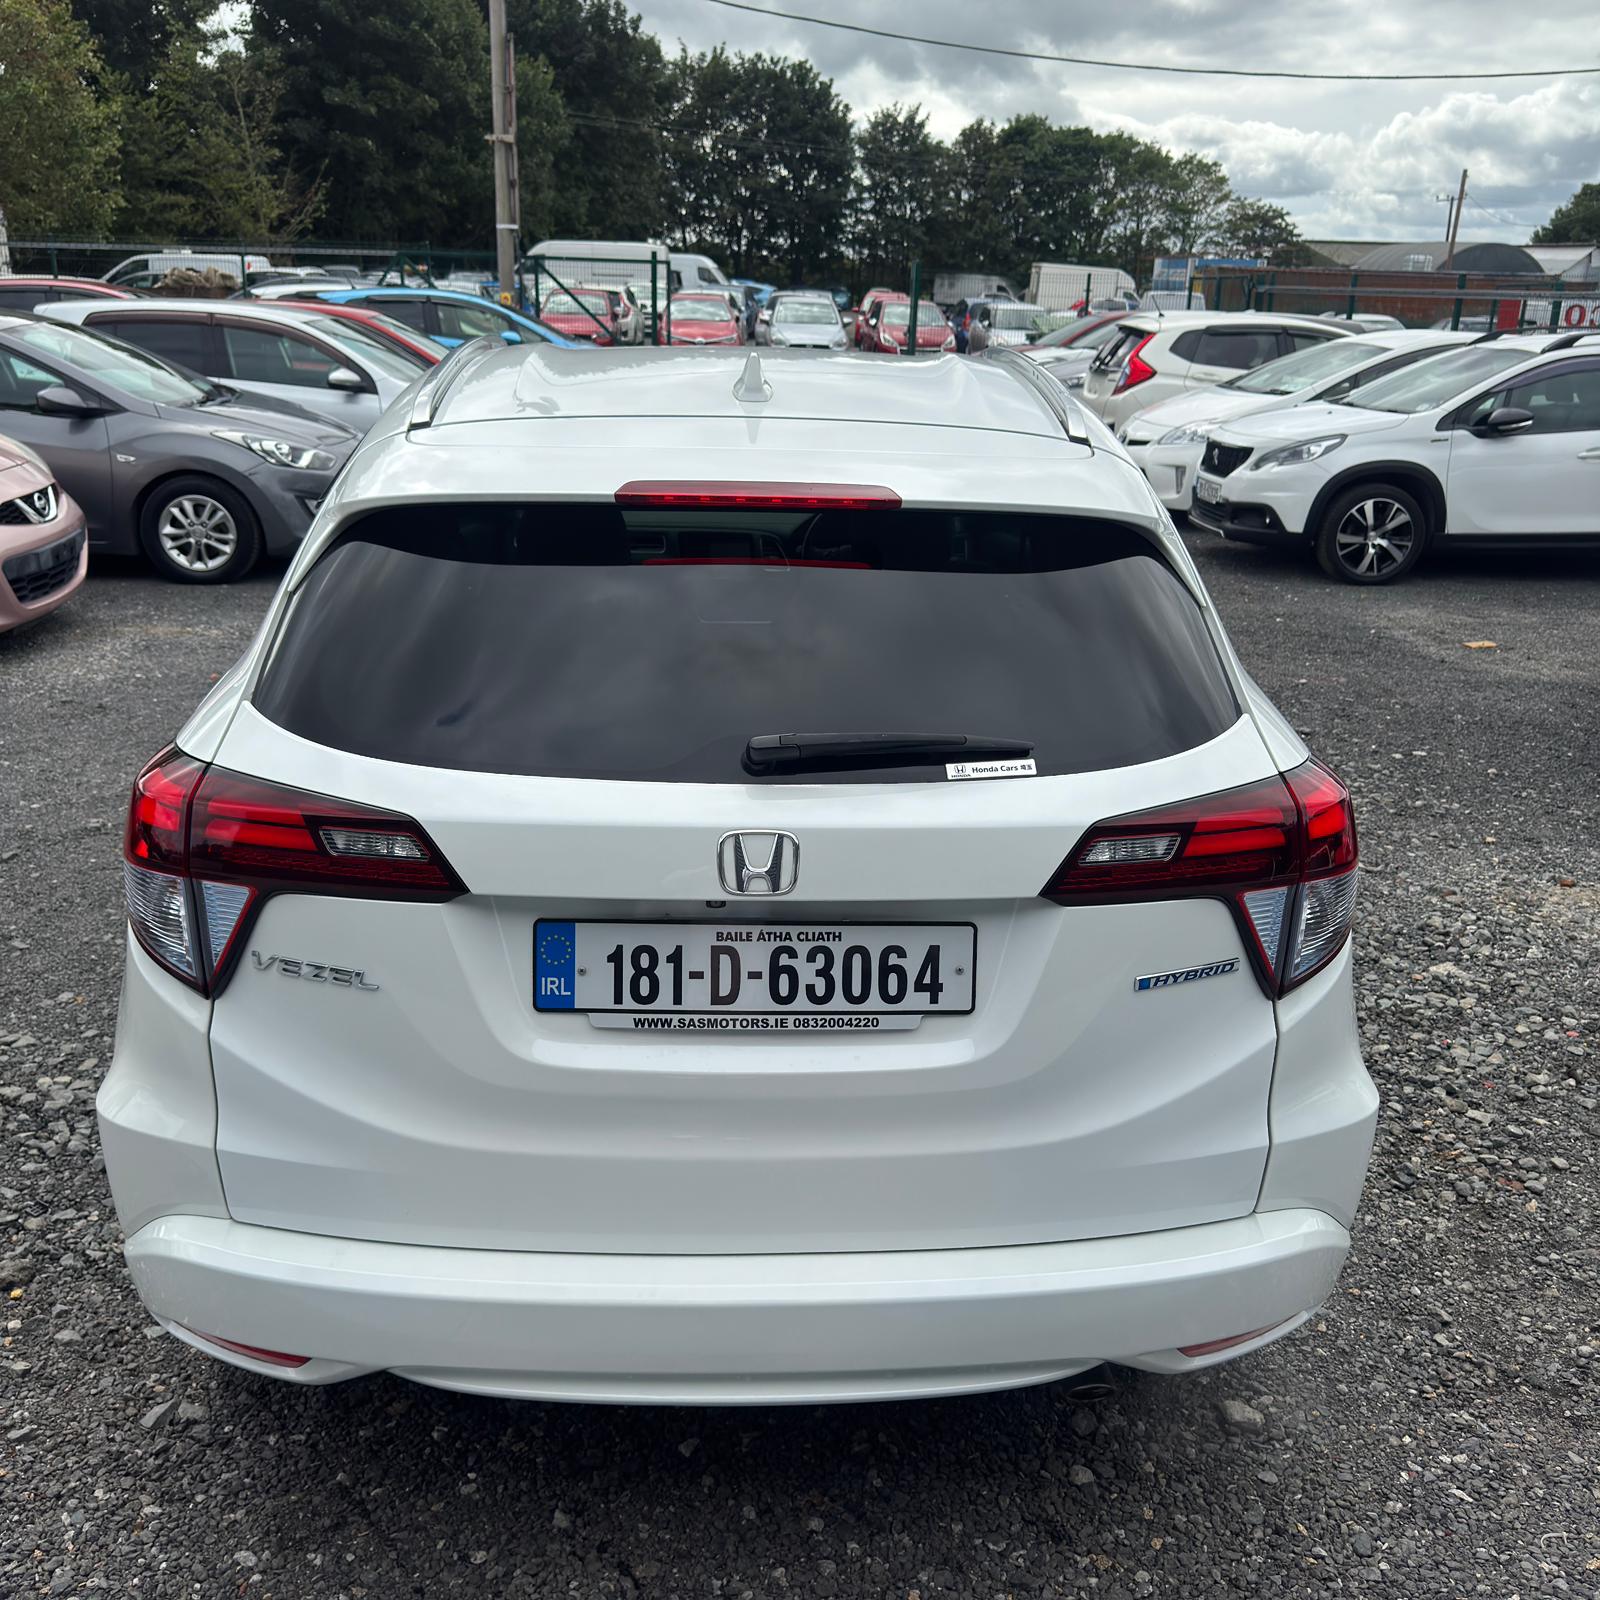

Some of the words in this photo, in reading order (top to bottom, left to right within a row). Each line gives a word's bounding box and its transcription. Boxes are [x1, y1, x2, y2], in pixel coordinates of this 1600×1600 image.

[972, 766, 999, 774] Honda
[1000, 764, 1018, 772] Cars
[715, 931, 753, 943] BAILE
[758, 928, 793, 943] ÁTHA
[795, 931, 842, 942] CLIATH
[251, 950, 380, 992] VEZEL
[606, 944, 944, 1006] 181-D-63064
[1153, 961, 1235, 986] HYBRID
[541, 977, 571, 996] IRL
[633, 1016, 789, 1030] WWW.SASMOTORS.IE
[793, 1016, 880, 1029] 0832004220
